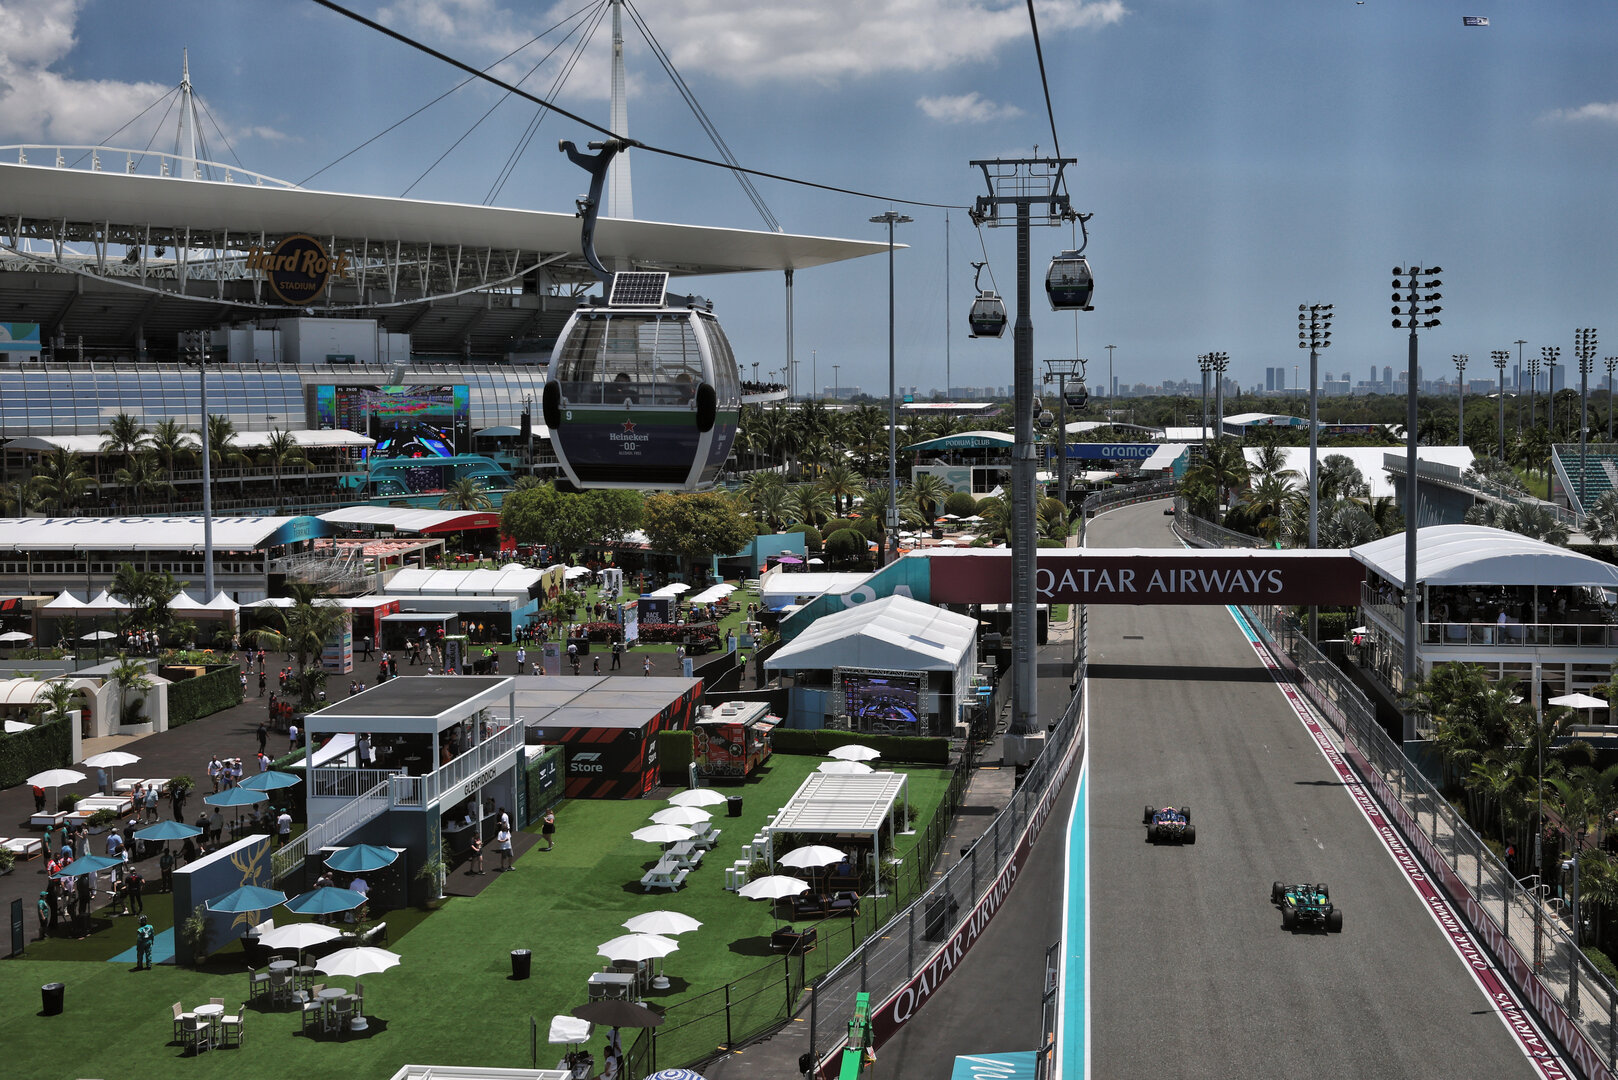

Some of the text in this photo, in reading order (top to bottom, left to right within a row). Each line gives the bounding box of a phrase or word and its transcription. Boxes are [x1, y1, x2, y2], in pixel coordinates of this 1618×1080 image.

[245, 245, 348, 279] Hard Rock
[280, 281, 317, 291] STADIUM
[566, 410, 573, 421] 9
[609, 432, 649, 442] Heineken
[1101, 445, 1154, 458] aramco
[1036, 568, 1284, 595] QATAR AIRWAYS
[464, 767, 497, 796] GLENFIDDICH
[570, 763, 603, 772] Store
[1370, 770, 1445, 882] QATAR AIRWAYS
[893, 856, 1017, 1024] QATAR AIRWAYS
[1427, 896, 1487, 971] QATAR AIRWAYS
[1466, 897, 1612, 1080] QATAR AIRWAY
[1496, 993, 1544, 1048] AIRWAYS
